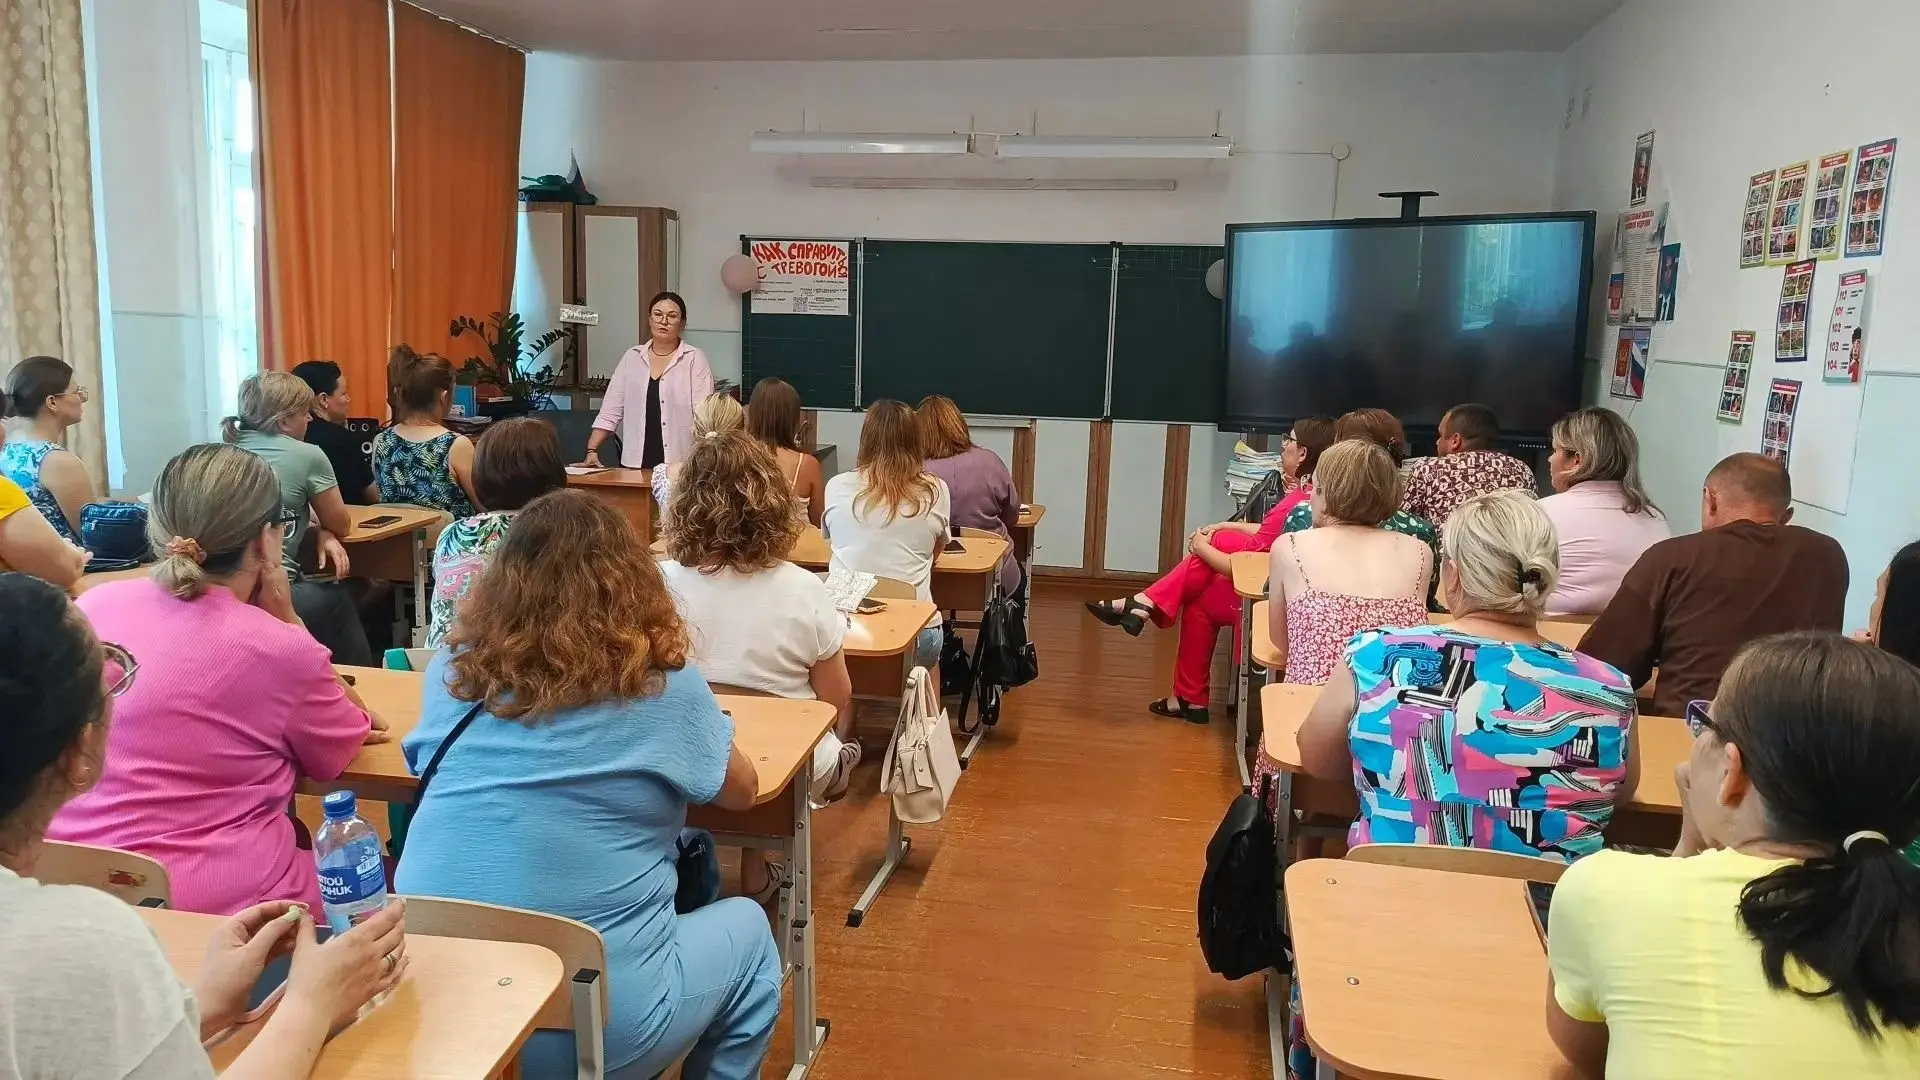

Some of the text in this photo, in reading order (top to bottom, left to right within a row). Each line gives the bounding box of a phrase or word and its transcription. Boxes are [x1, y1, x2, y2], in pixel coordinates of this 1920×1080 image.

[752, 242, 787, 264] КАК
[757, 261, 837, 279] С ТРЕВОГОЙ
[1829, 342, 1839, 352] 103
